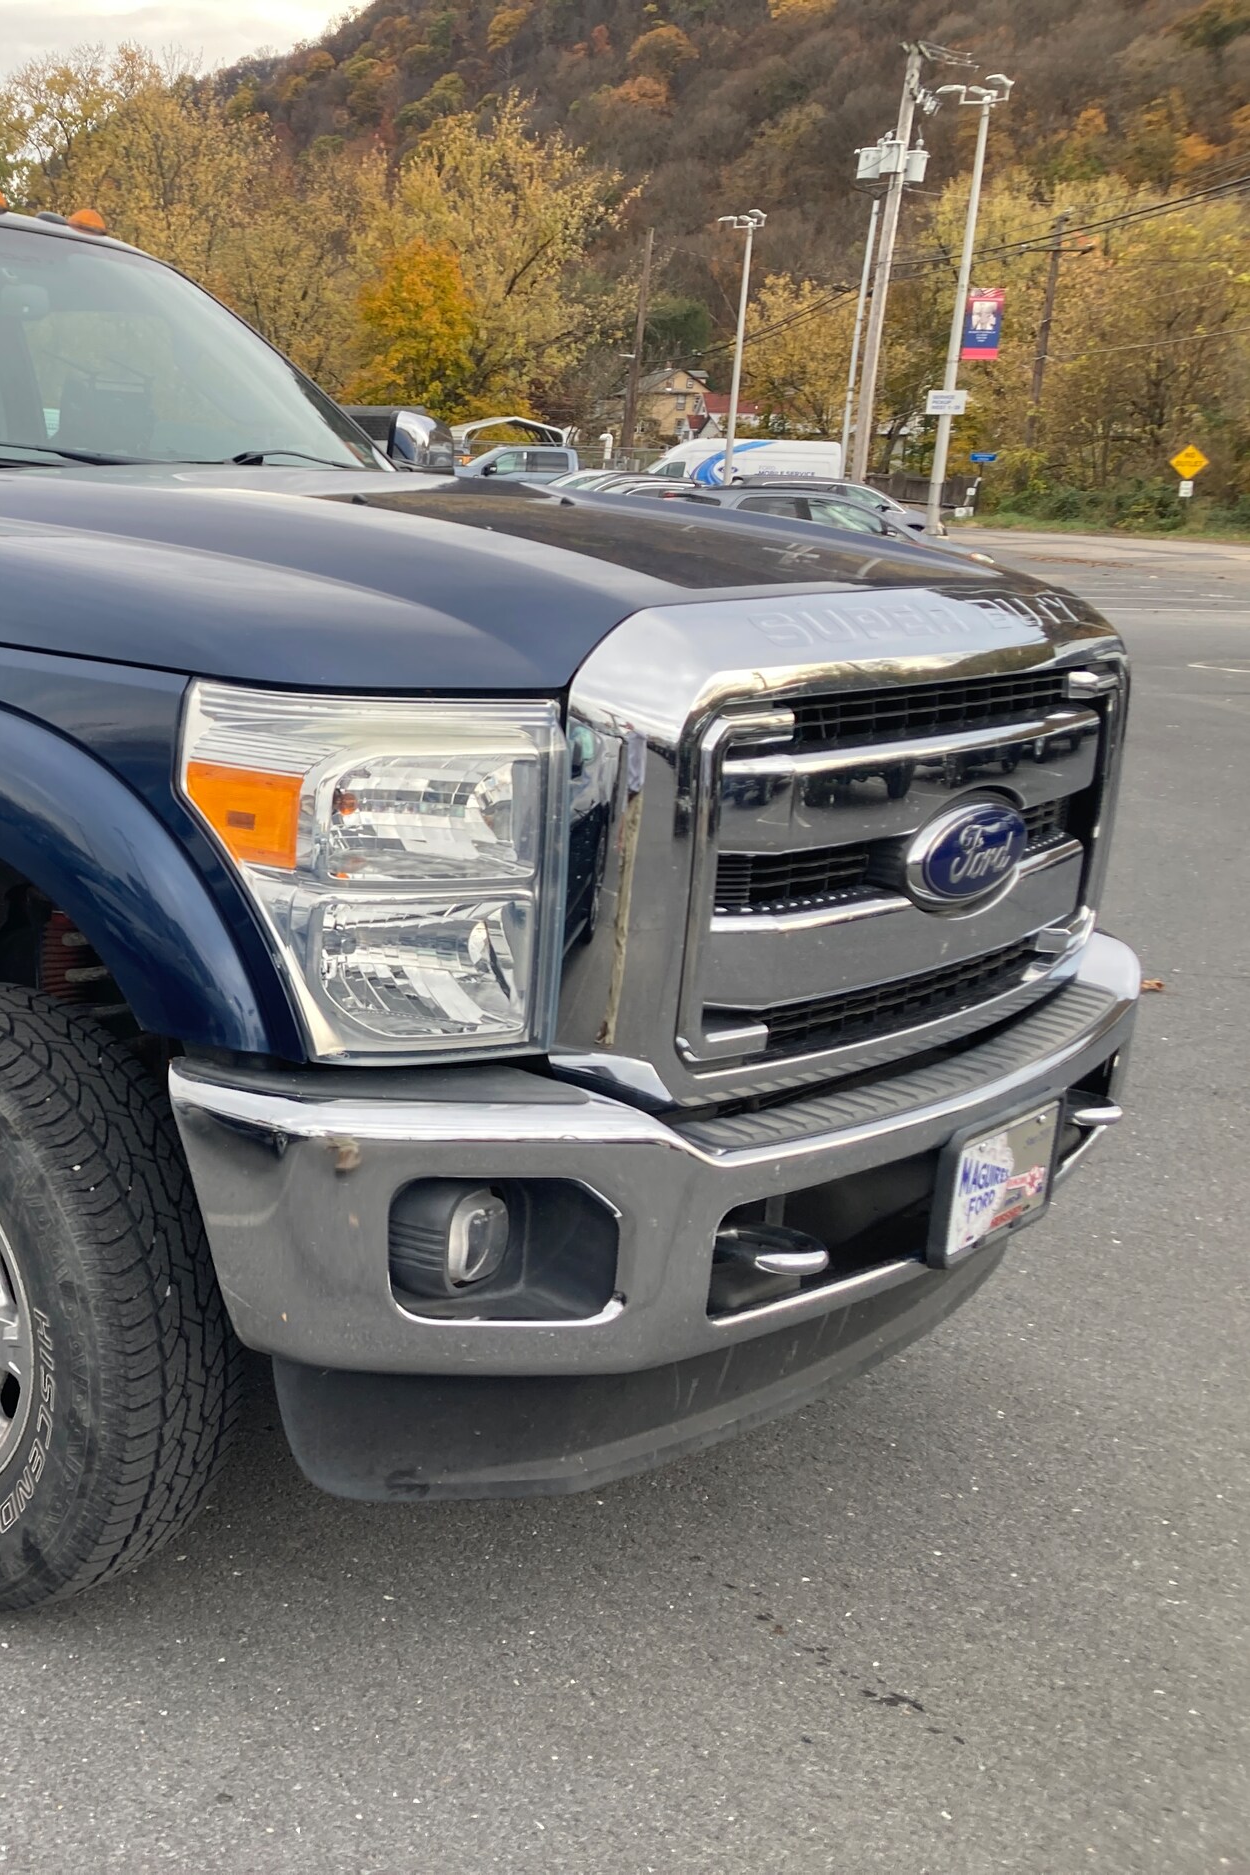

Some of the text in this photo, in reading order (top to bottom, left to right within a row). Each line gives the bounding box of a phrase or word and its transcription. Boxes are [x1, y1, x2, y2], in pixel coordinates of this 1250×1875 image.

[748, 596, 1082, 648] SUPER DUTY
[949, 821, 1014, 884] Ford
[966, 1189, 997, 1225] FORD
